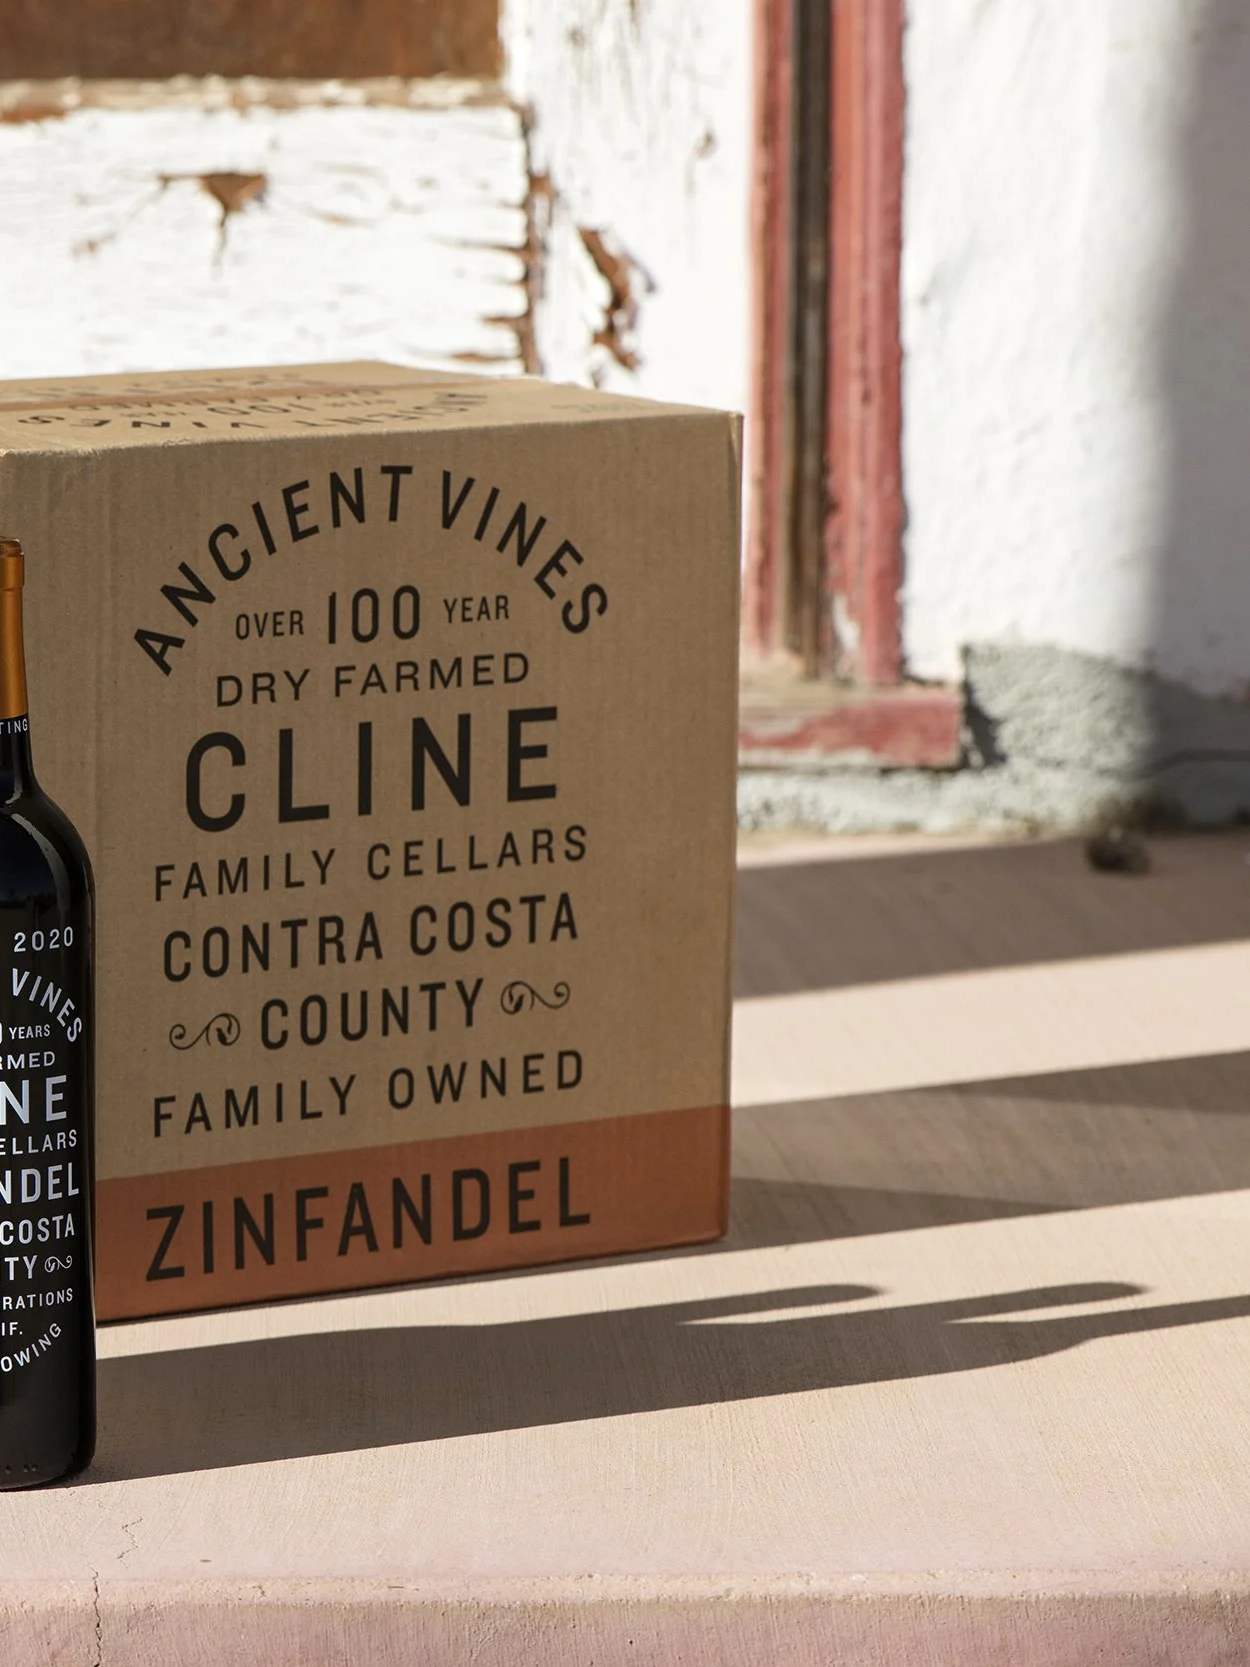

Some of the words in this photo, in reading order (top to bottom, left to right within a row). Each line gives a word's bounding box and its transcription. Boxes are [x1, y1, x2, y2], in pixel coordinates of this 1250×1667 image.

[17, 415, 268, 428] VINES
[206, 402, 316, 415] 100
[133, 465, 413, 676] ANCIENT
[442, 470, 609, 634] VINES
[235, 610, 305, 640] OVER
[327, 585, 421, 644] 100
[443, 595, 510, 624] YEAR
[216, 669, 310, 707] DRY
[334, 653, 529, 698] FARMED
[185, 706, 557, 833] CLINE
[155, 849, 336, 901] FAMILY
[367, 825, 587, 880] CELLARS
[13, 926, 73, 952] 2020
[163, 912, 383, 982] CONTRA
[409, 892, 578, 956] COSTA
[8, 1024, 50, 1040] YEARS
[12, 967, 83, 1042] VINES
[260, 978, 484, 1050] COUNTY
[153, 1074, 356, 1138] FAMILY
[388, 1050, 583, 1109] OWNED
[0, 1213, 75, 1246] COSTA
[145, 1156, 591, 1282] ZINFANDEL
